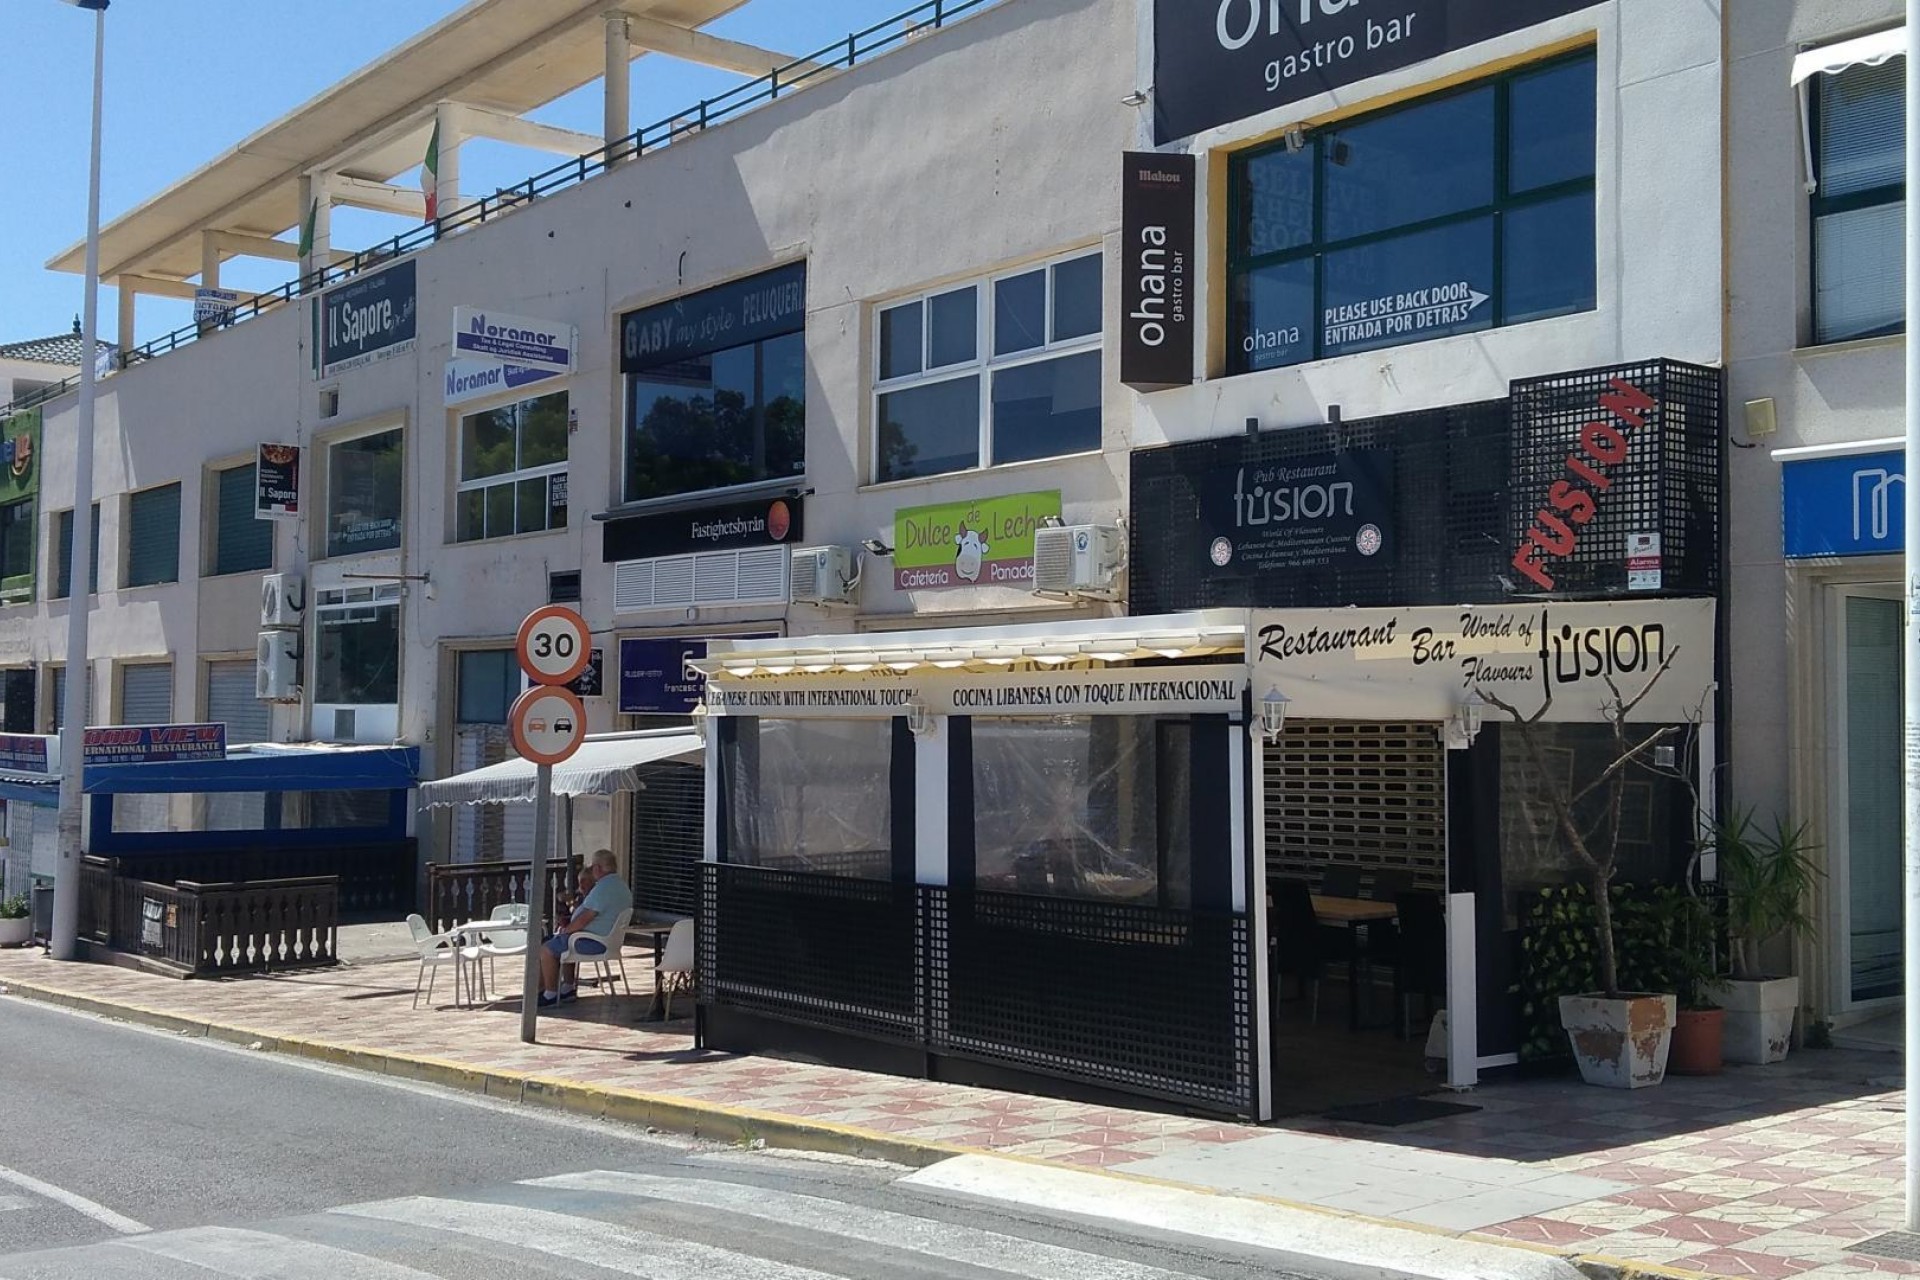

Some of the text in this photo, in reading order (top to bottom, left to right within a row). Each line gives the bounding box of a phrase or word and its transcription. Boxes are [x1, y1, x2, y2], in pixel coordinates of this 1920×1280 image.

[1264, 36, 1355, 92] gastro
[1366, 12, 1416, 50] bar
[1139, 169, 1180, 182] Mahou
[1130, 225, 1166, 346] ohana
[1171, 251, 1185, 322] gastro bar
[1325, 281, 1468, 325] PLEASE USE BACK DOOR
[342, 298, 392, 350] Sapore
[470, 313, 556, 346] Noramar
[625, 317, 673, 359] GABY
[676, 323, 697, 347] my
[700, 307, 734, 341] style
[1243, 326, 1299, 352] ohana
[1325, 304, 1469, 346] ENTRADA POR DETRAS
[446, 367, 501, 396] Noramar
[1253, 463, 1337, 483] Pub Restaurant
[1511, 375, 1656, 591] FUSION
[268, 487, 297, 500] Sapore
[691, 516, 765, 541] Fastighetsbyrån
[904, 516, 950, 549] Dulce
[966, 505, 980, 524] de
[900, 561, 1035, 588] Cafetería Panade
[534, 633, 574, 658] 30
[1258, 617, 1457, 665] Restaurant Bar
[1460, 613, 1535, 647] World of
[1461, 656, 1534, 688] Flavours
[708, 688, 912, 706] LEBANESE CUISINE WITH INTERNATIONAL TOUCH
[953, 679, 1236, 707] COCINA LIBANESA CON TOQUE INTERNACIONAL
[84, 726, 222, 745] OOD VIEW
[85, 741, 219, 755] ERNATIONAL RESTAURANTE
